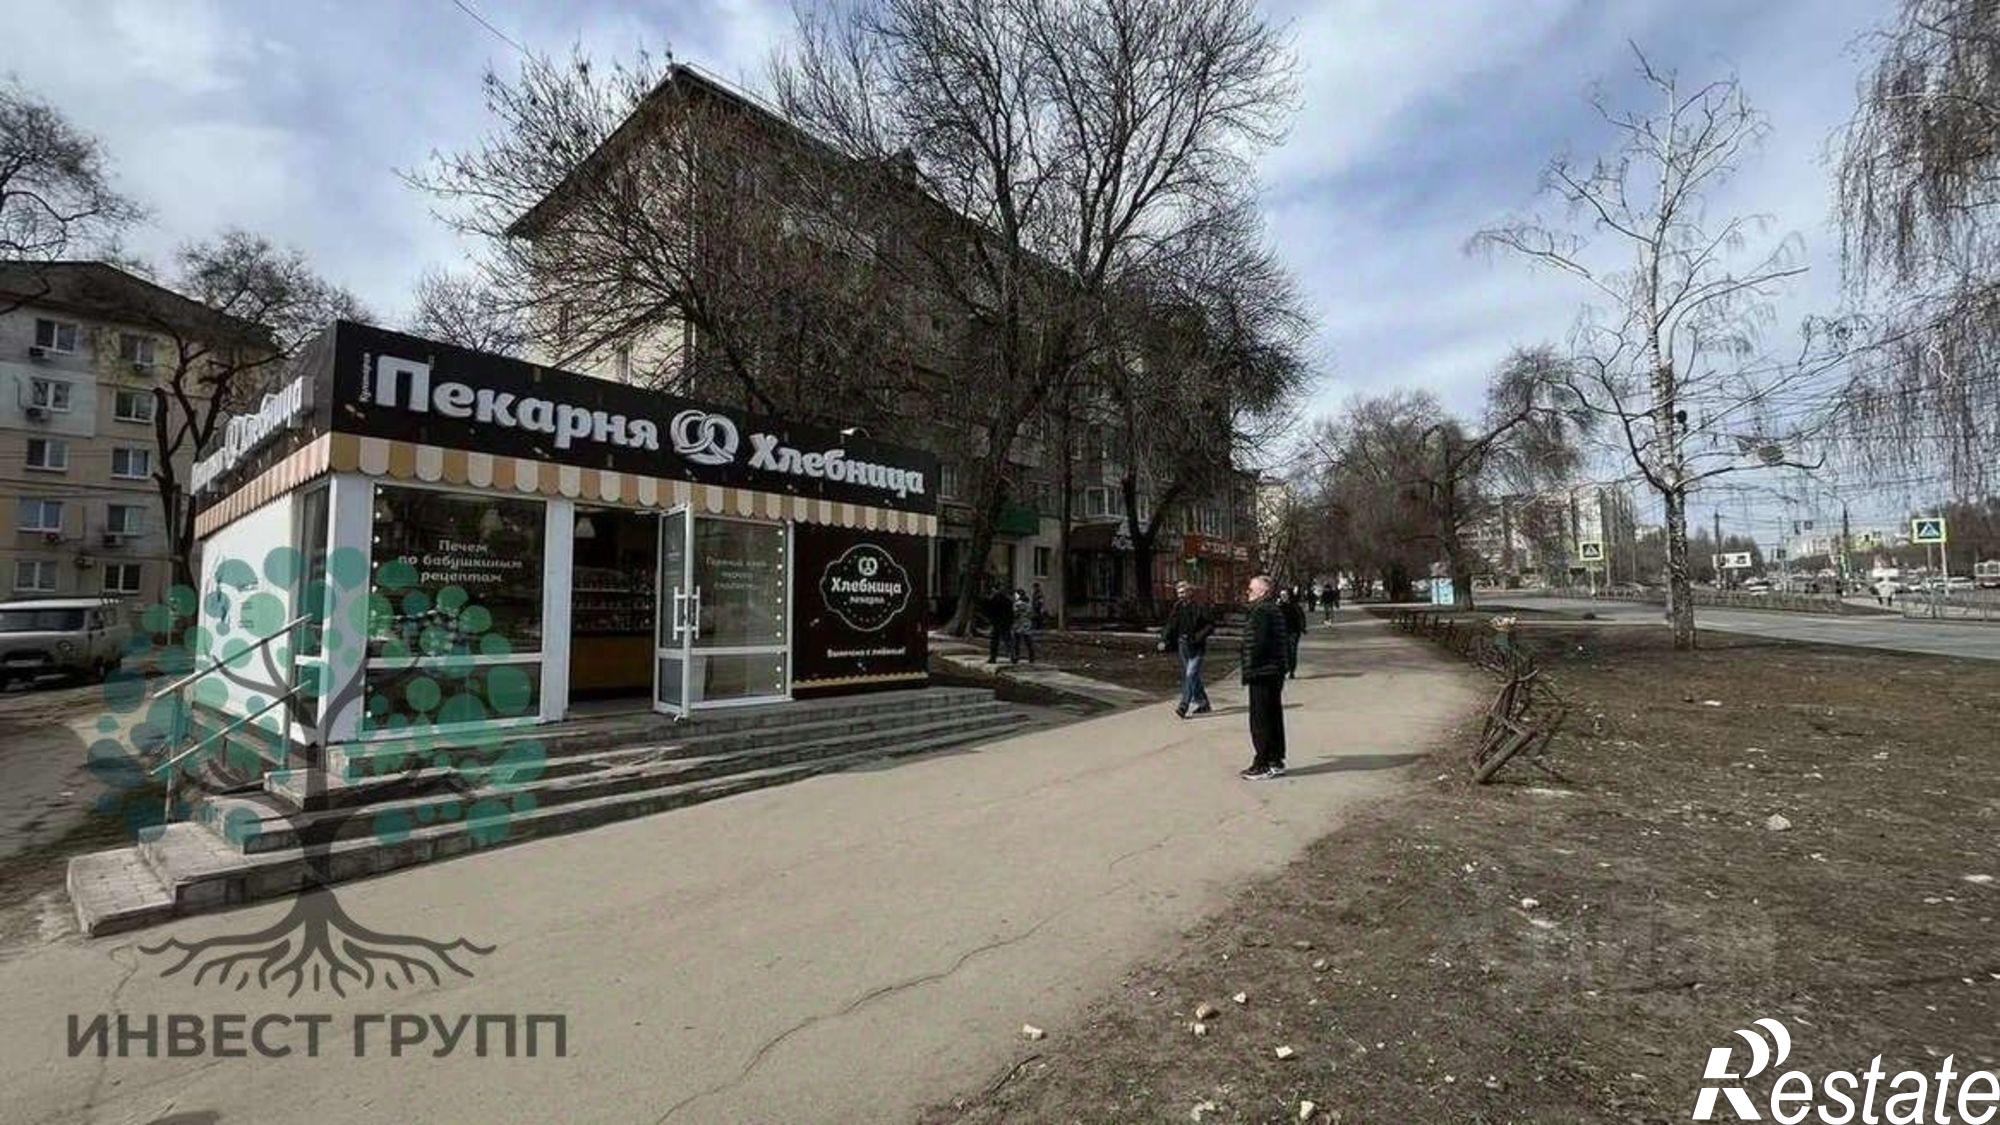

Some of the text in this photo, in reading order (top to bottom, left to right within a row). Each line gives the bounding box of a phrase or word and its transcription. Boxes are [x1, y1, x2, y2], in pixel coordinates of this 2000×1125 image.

[375, 355, 926, 498] Пекарня Хлебница
[831, 577, 902, 596] Хлебница
